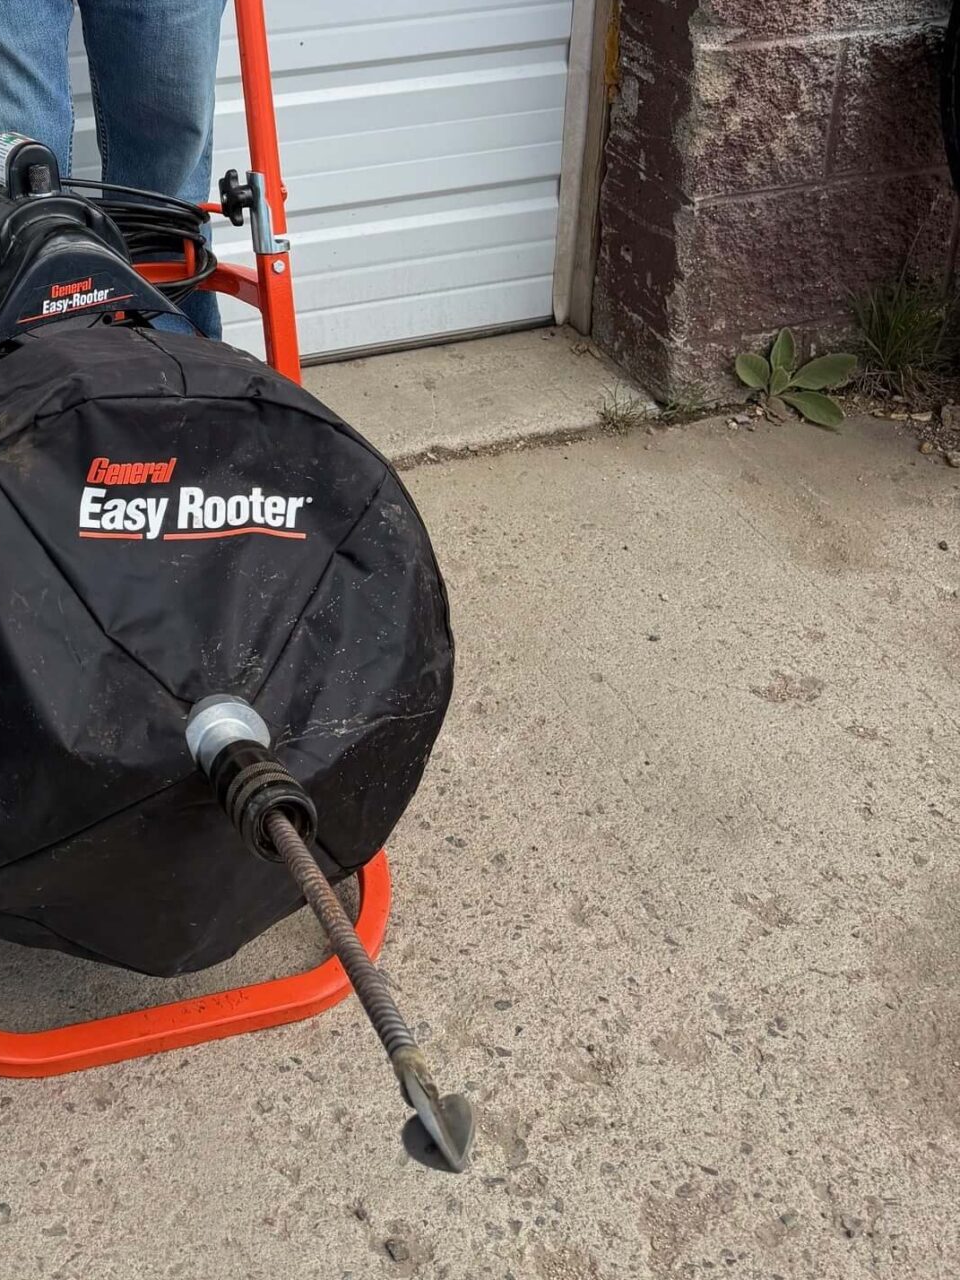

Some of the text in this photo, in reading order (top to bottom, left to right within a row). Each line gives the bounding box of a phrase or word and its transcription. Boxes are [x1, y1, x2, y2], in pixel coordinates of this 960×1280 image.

[51, 277, 92, 299] General
[86, 457, 177, 486] General
[79, 486, 305, 540] Easy Rooter
